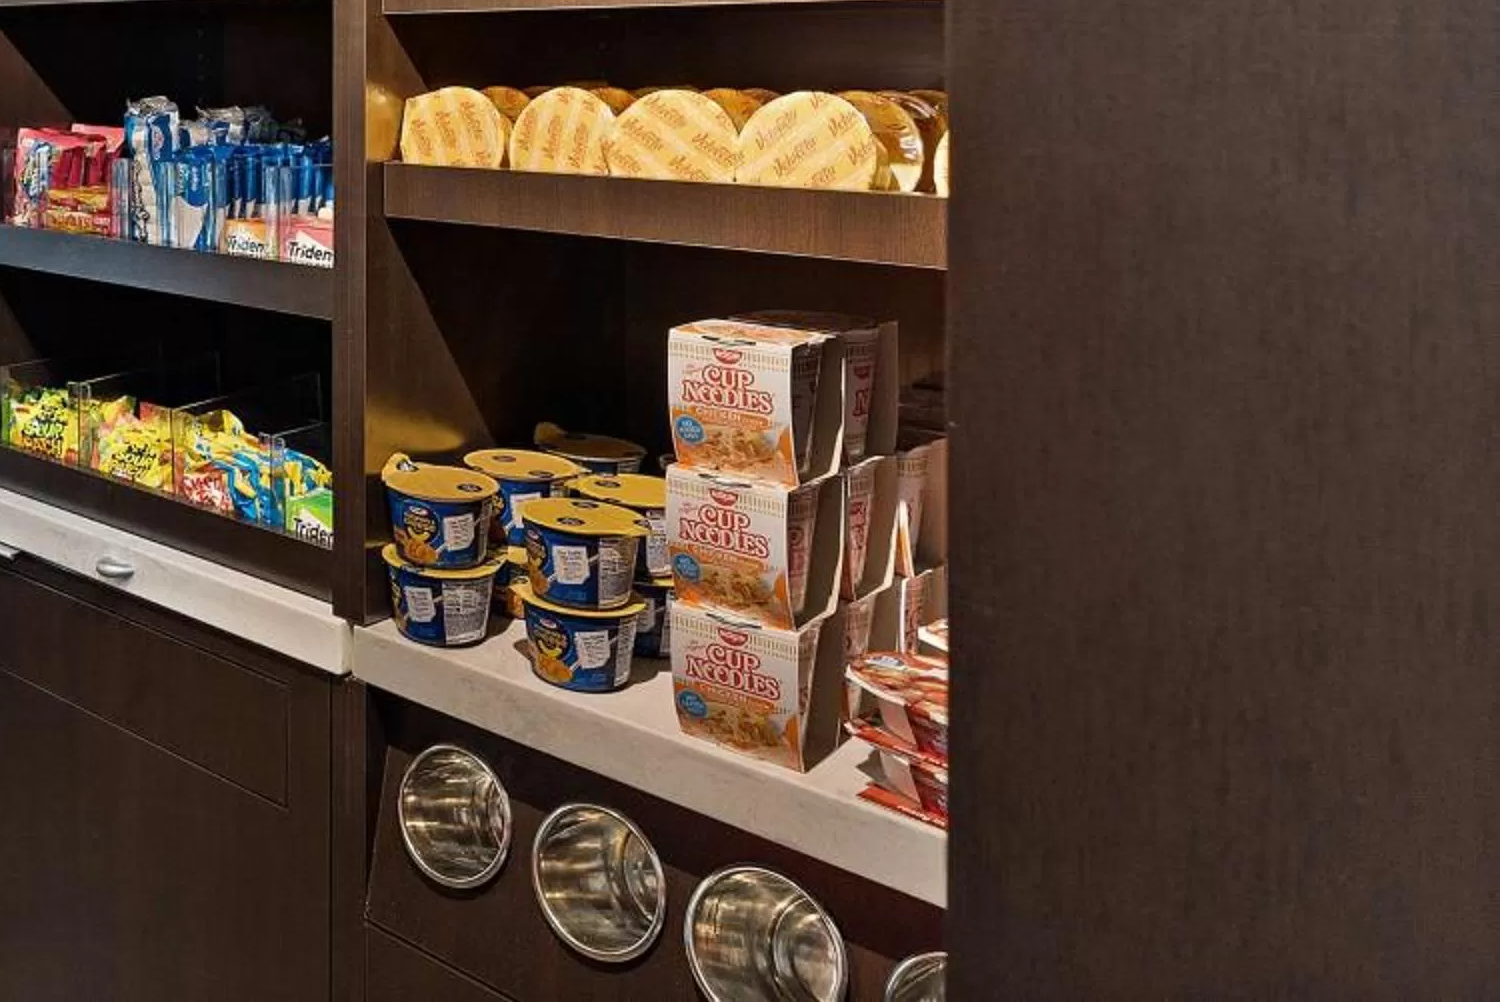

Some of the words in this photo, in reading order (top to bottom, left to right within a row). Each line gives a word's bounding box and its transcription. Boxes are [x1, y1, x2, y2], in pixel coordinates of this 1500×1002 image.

[227, 236, 265, 254] Triden
[289, 241, 333, 261] Triden
[701, 364, 755, 389] CUP
[680, 378, 774, 415] NOODLES
[698, 503, 752, 531] CUP
[678, 517, 770, 559] NOODLES
[705, 643, 761, 672] CUP
[685, 653, 781, 701] NOODLES
